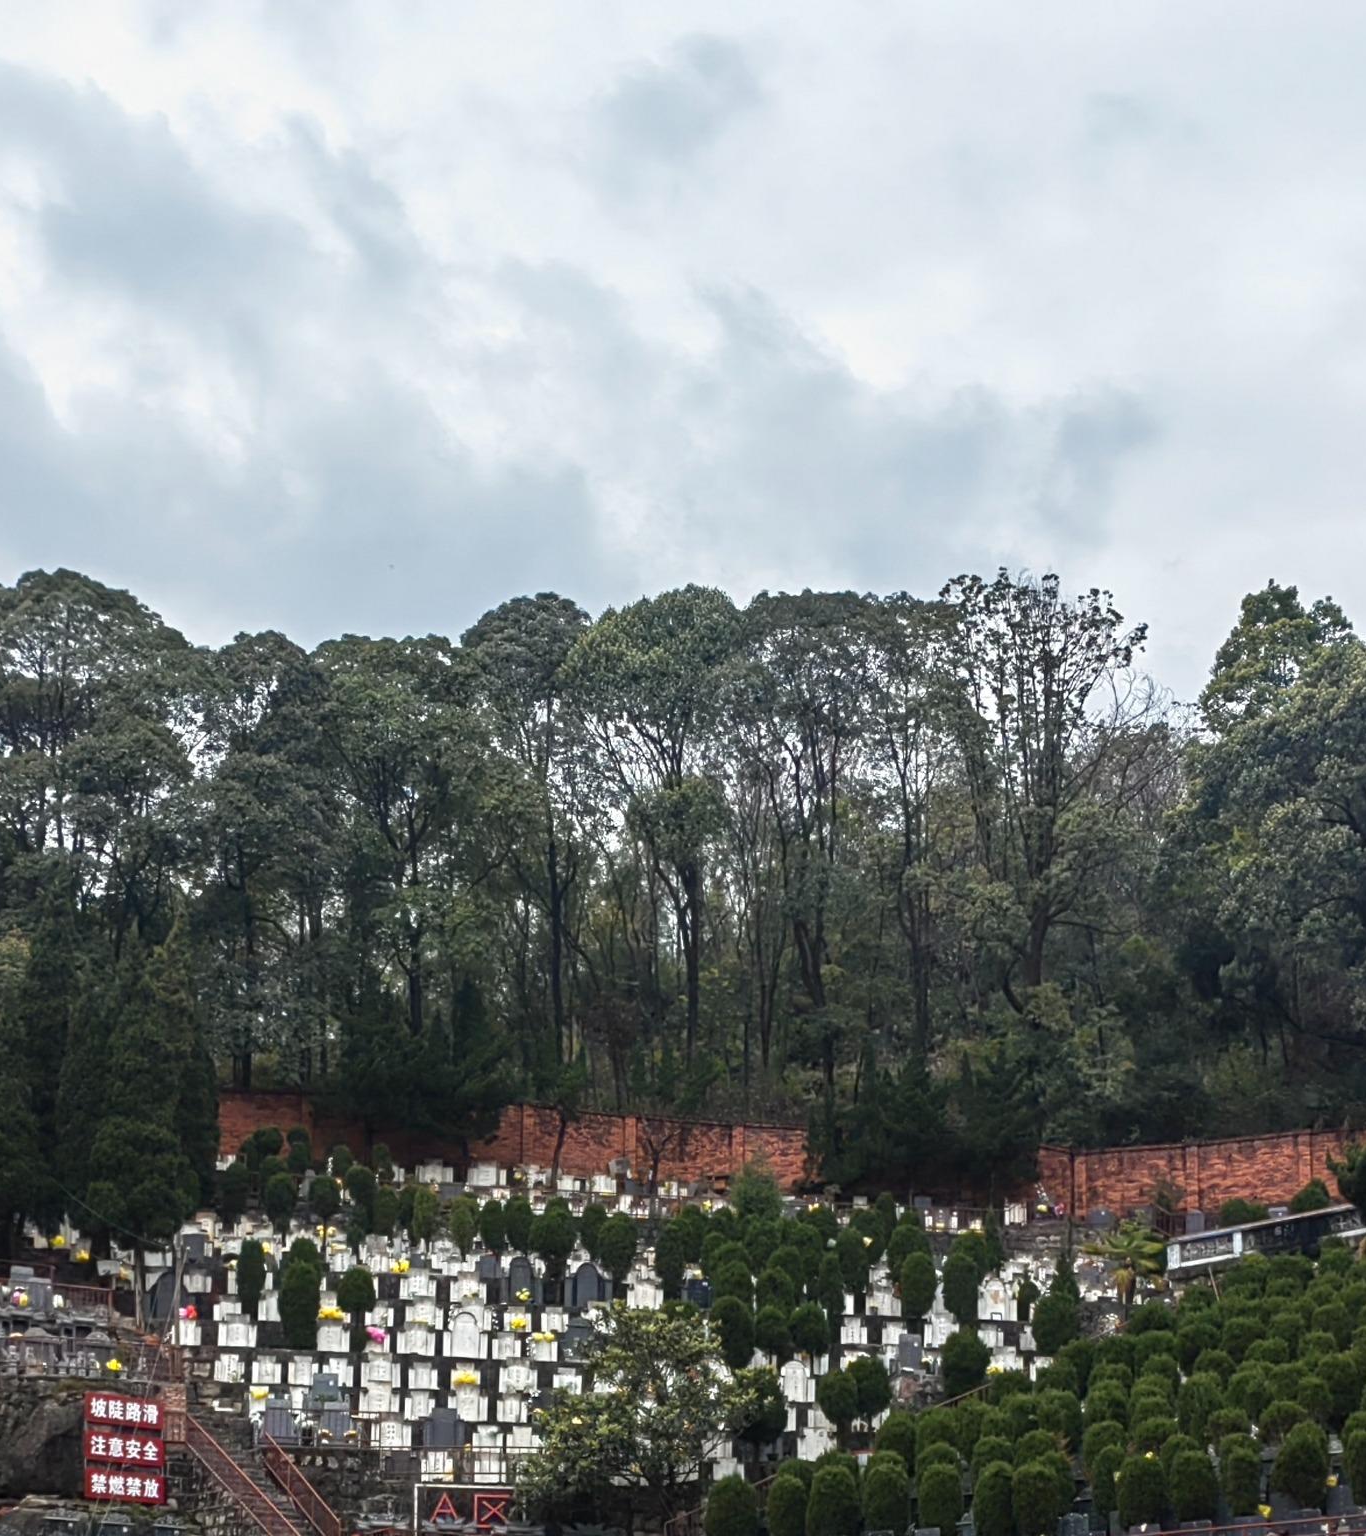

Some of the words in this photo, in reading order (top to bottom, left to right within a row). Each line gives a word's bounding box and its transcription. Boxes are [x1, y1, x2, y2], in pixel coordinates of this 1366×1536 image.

[90, 1397, 159, 1425] 坡陡路滑
[90, 1435, 159, 1461] 注意安全
[91, 1473, 159, 1499] 禁燃禁放
